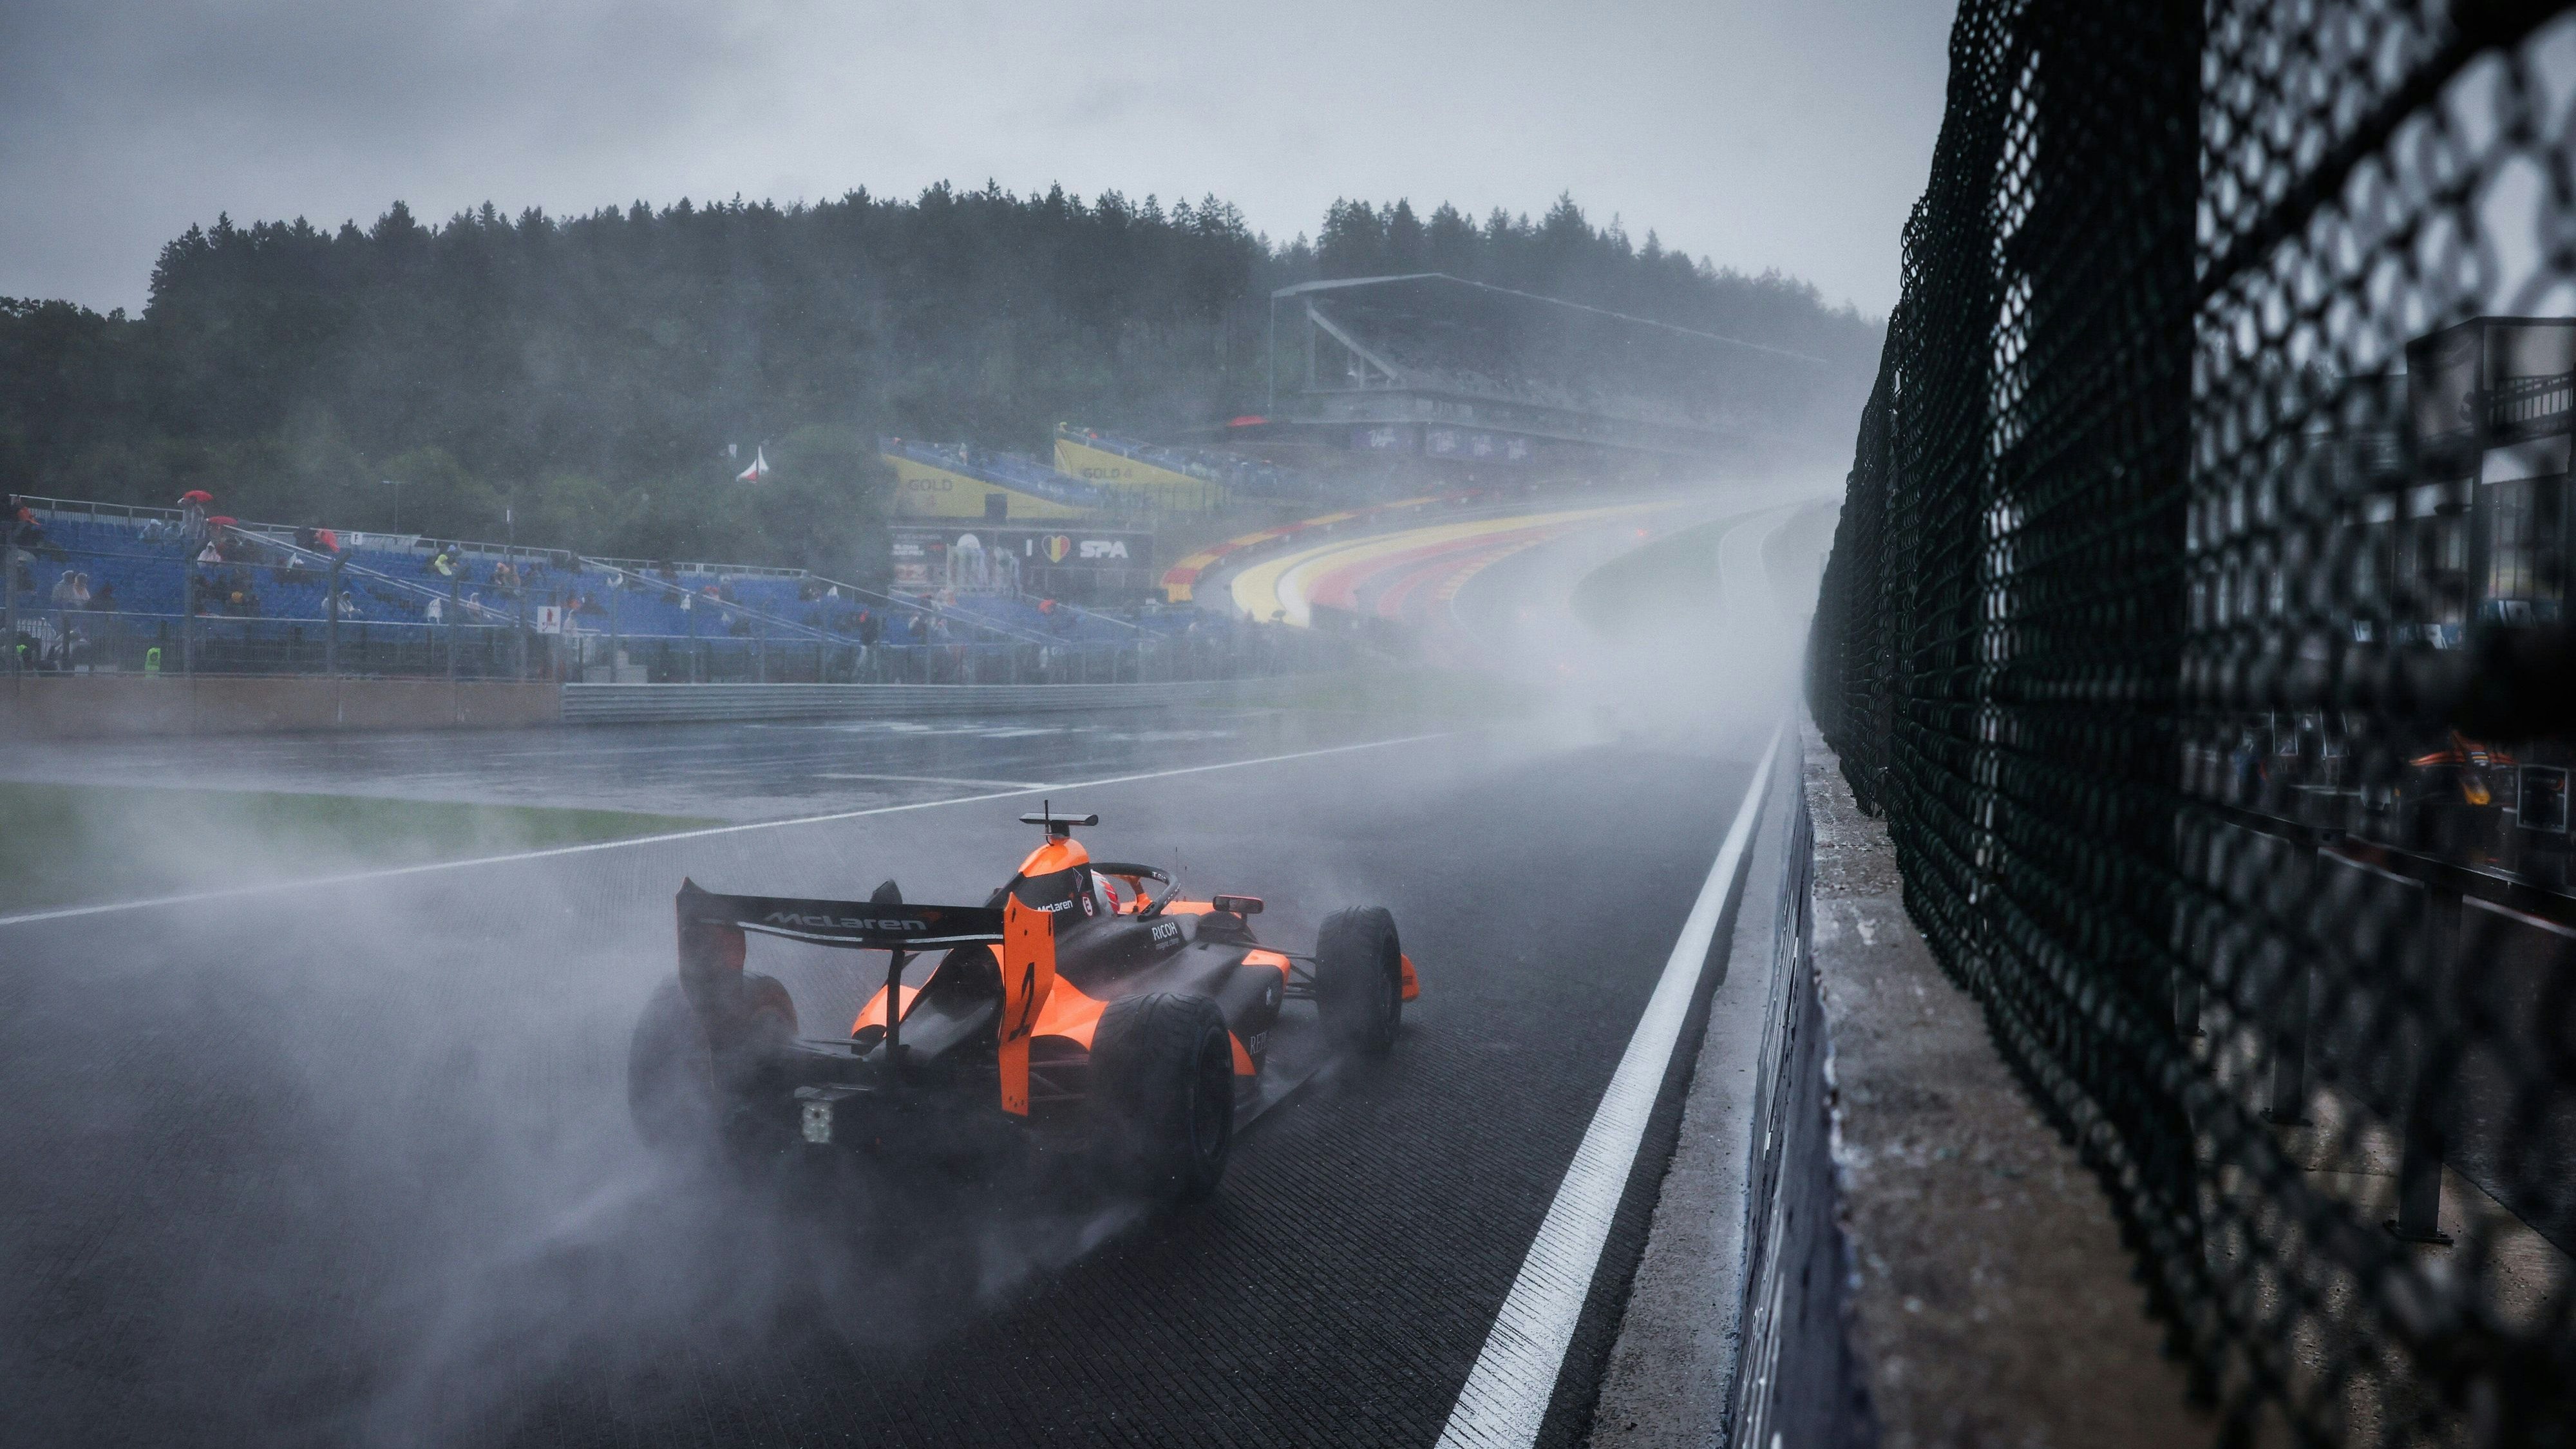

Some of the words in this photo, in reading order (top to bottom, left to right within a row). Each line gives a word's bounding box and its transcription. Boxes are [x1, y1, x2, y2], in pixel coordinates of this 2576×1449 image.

[1081, 468, 1119, 478] GOLD
[907, 478, 952, 491] GOLD
[1026, 538, 1032, 556] I
[1080, 540, 1129, 558] SPA
[1037, 900, 1074, 913] McLaren
[763, 912, 927, 931] McLaren
[1151, 922, 1178, 941] RICOH
